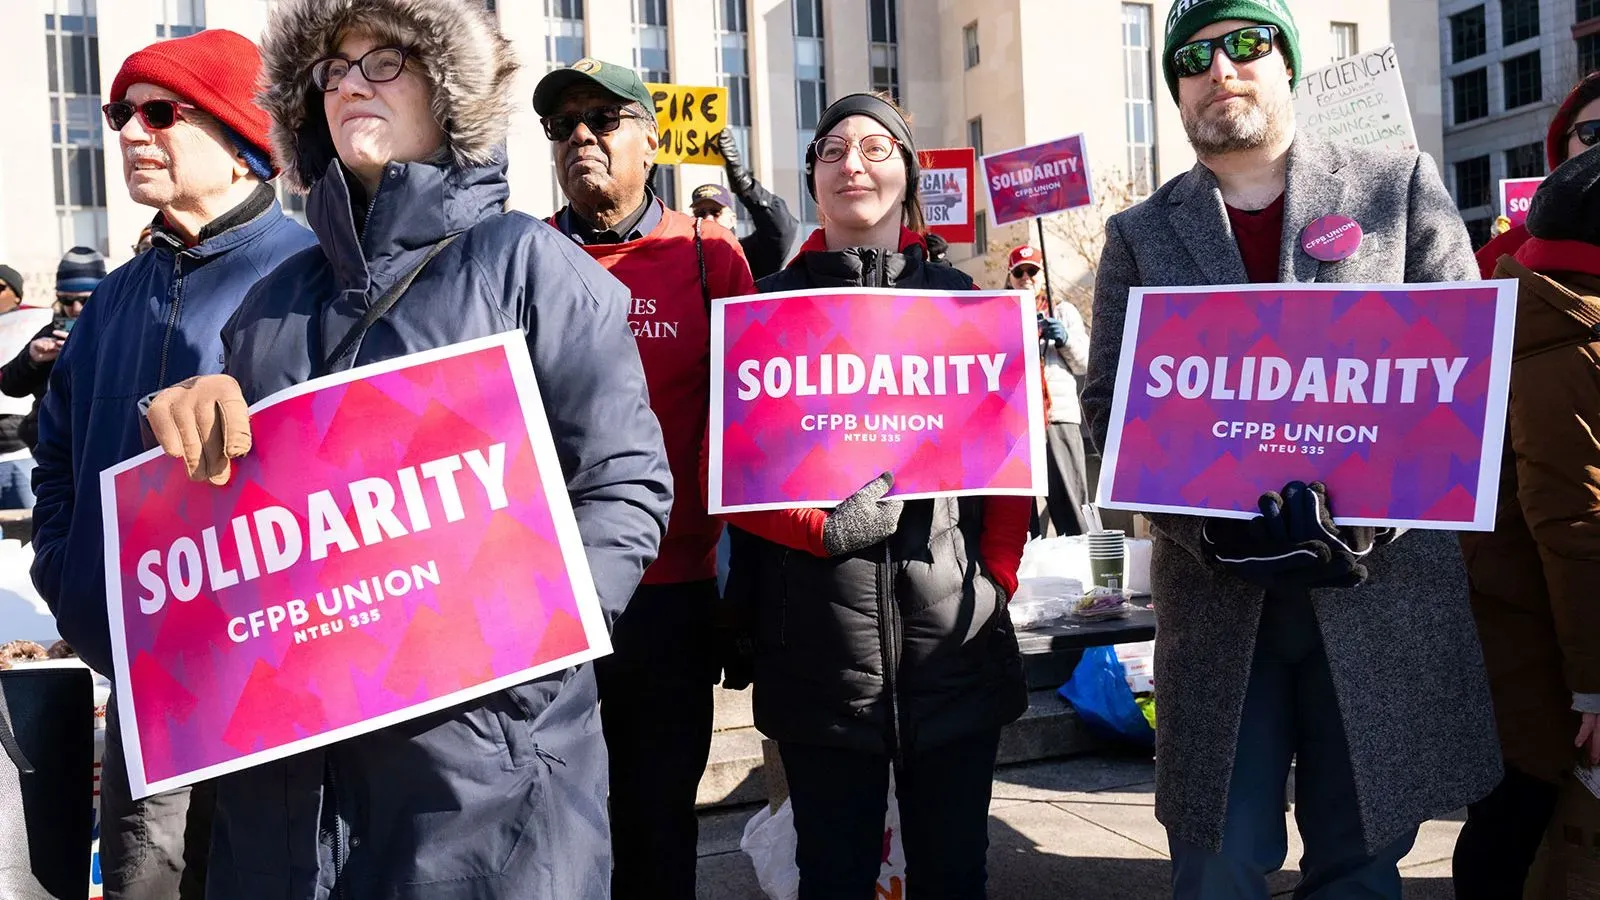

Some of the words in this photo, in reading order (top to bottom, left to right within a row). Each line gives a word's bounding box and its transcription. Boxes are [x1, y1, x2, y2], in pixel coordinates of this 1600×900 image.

[1292, 46, 1397, 101] FICIENCY?
[652, 91, 719, 123] FIRE
[657, 128, 722, 157] MUSK
[991, 156, 1078, 192] SOLIDARITY
[1033, 181, 1061, 194] UNION
[922, 205, 951, 221] USK
[1326, 221, 1356, 240] UNION
[737, 352, 1008, 402] SOLIDARITY
[1145, 354, 1470, 405] SOLIDARITY
[800, 413, 858, 432] CFPB
[864, 413, 945, 432] UNION
[843, 432, 878, 443] NTEU
[880, 433, 902, 443] 335
[1211, 420, 1277, 441] CFPB
[1283, 423, 1379, 444] UNION
[1258, 443, 1297, 455] NTEU
[1301, 445, 1326, 456] 335
[136, 441, 511, 616] SOLIDARITY
[227, 599, 311, 644] CFPB
[315, 559, 442, 618] UNION
[293, 618, 344, 645] NTEU
[348, 607, 382, 629] 335
